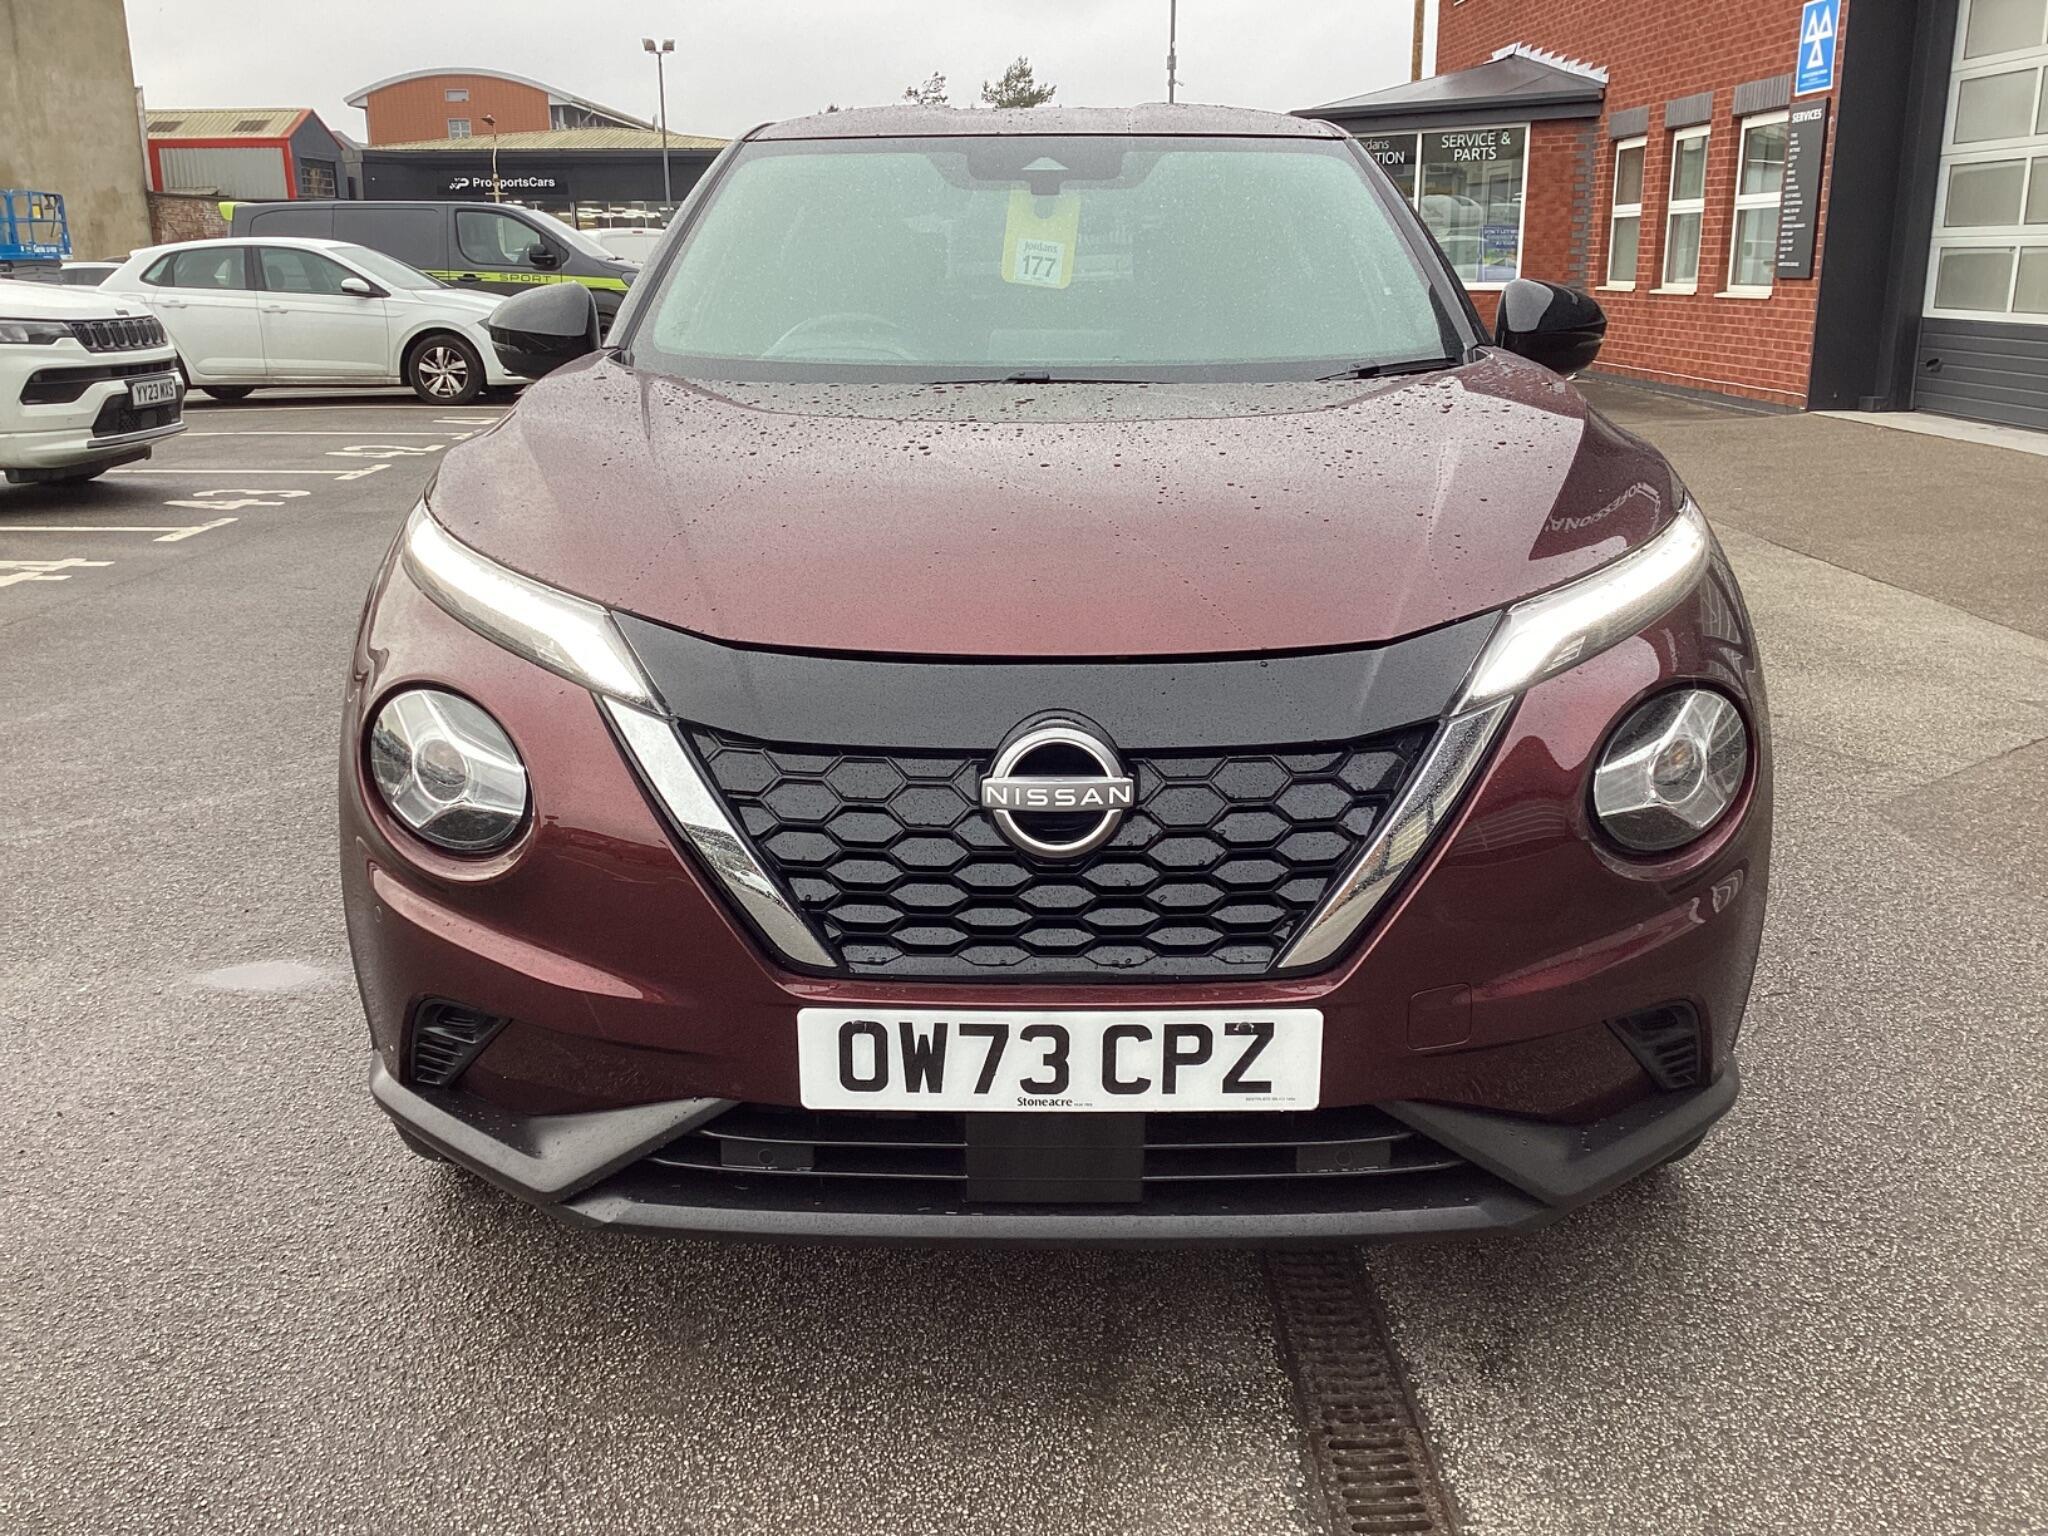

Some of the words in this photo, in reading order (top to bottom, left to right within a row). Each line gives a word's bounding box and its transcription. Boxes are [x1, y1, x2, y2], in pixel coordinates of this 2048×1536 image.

[1441, 132, 1497, 148] SERVICE
[1501, 131, 1511, 145] &
[1453, 146, 1497, 162] PARTS
[472, 176, 556, 190] ProportsCars
[1023, 255, 1056, 278] 177
[499, 273, 552, 283] SPORT
[136, 383, 159, 402] YY23
[986, 785, 1131, 807] NISSAN
[837, 1020, 1070, 1096] OW73
[1101, 1022, 1276, 1096] CPZ
[1016, 1096, 1073, 1108] Stoneacre
